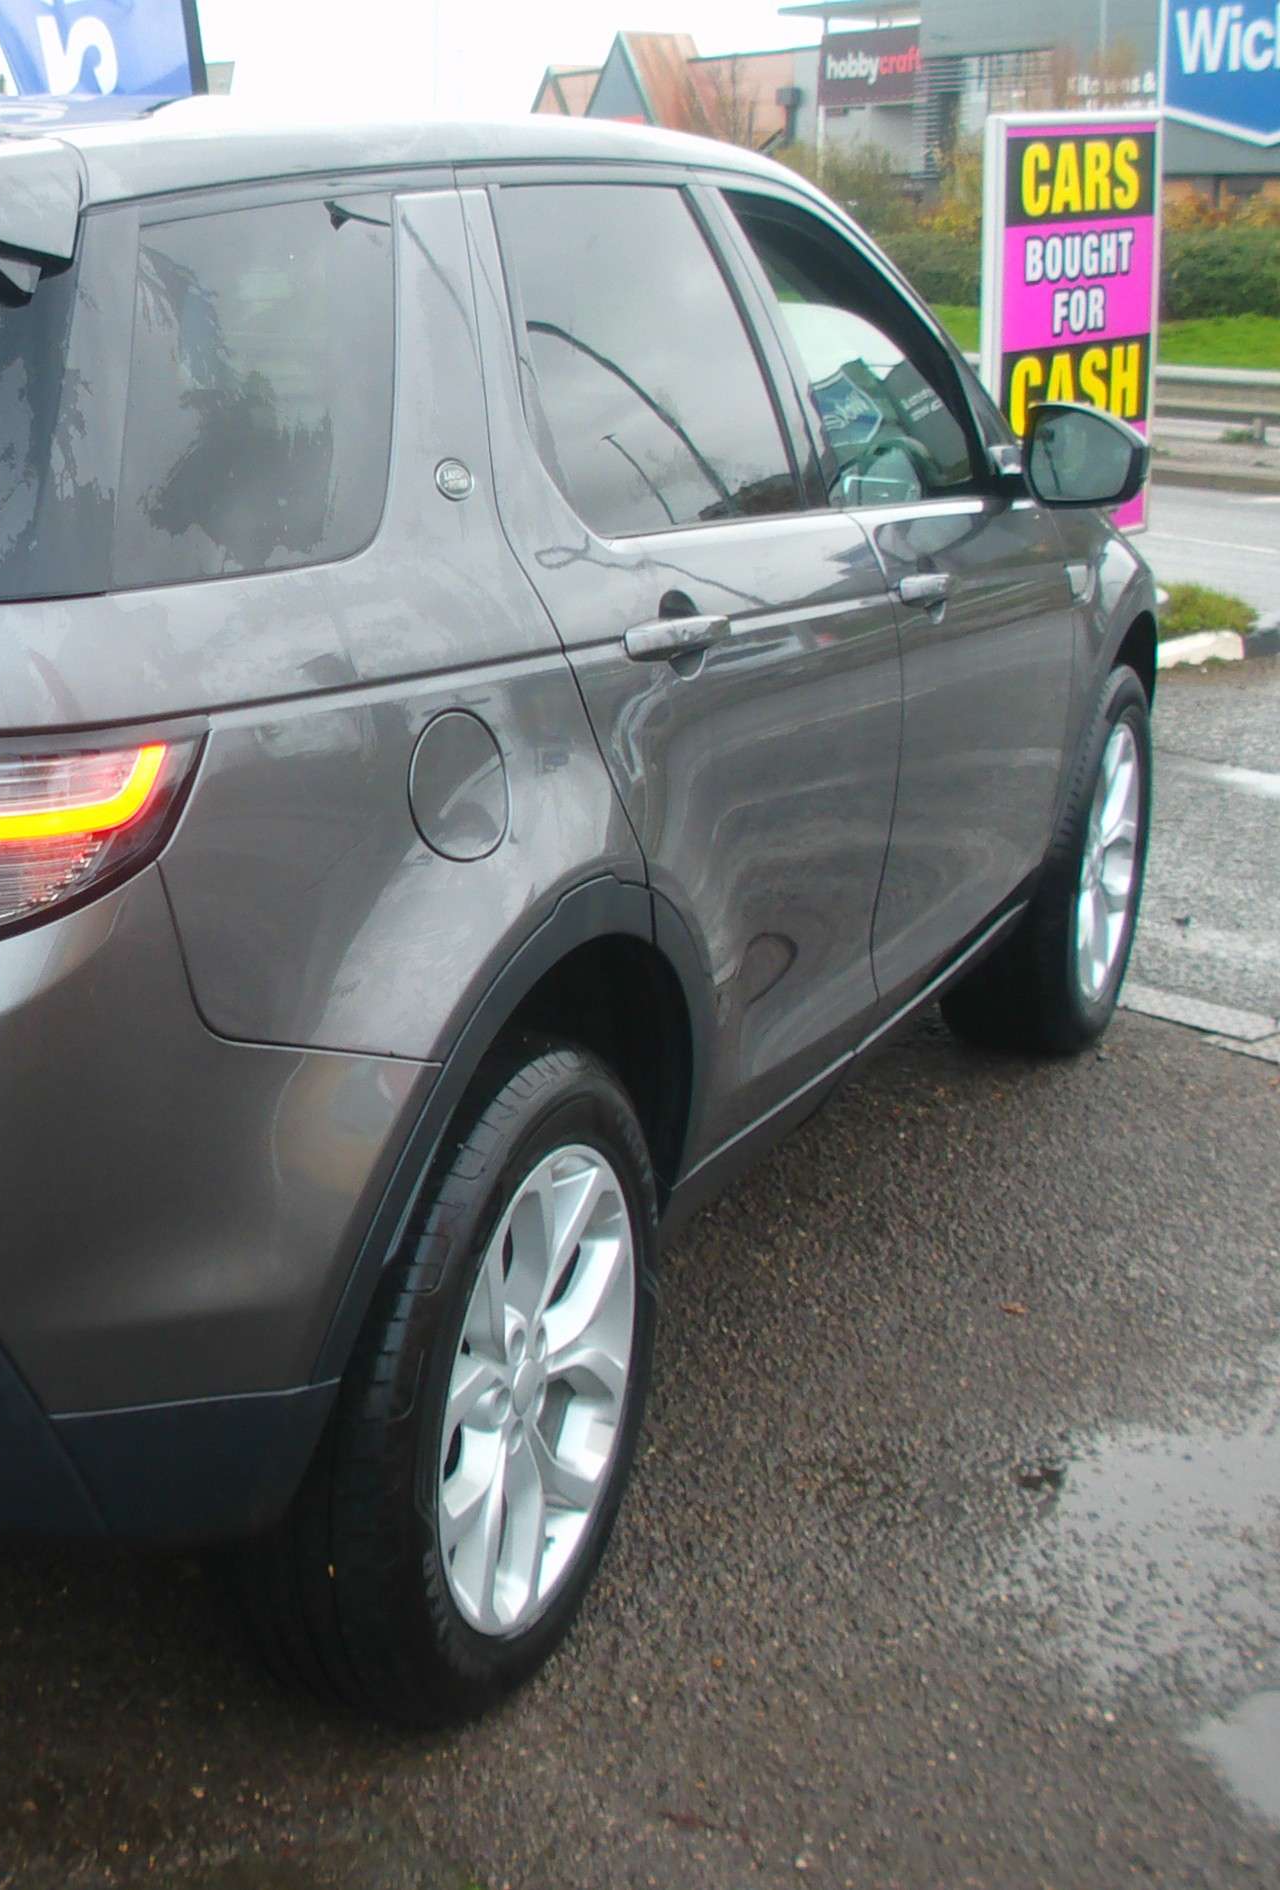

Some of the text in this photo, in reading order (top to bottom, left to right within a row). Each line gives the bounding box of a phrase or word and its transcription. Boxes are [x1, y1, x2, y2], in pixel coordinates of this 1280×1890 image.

[1175, 5, 1280, 74] Wic
[1021, 139, 1139, 216] CARS
[1024, 229, 1135, 284] BOUGHT
[1052, 287, 1105, 335] FOR
[1010, 343, 1140, 437] CASH
